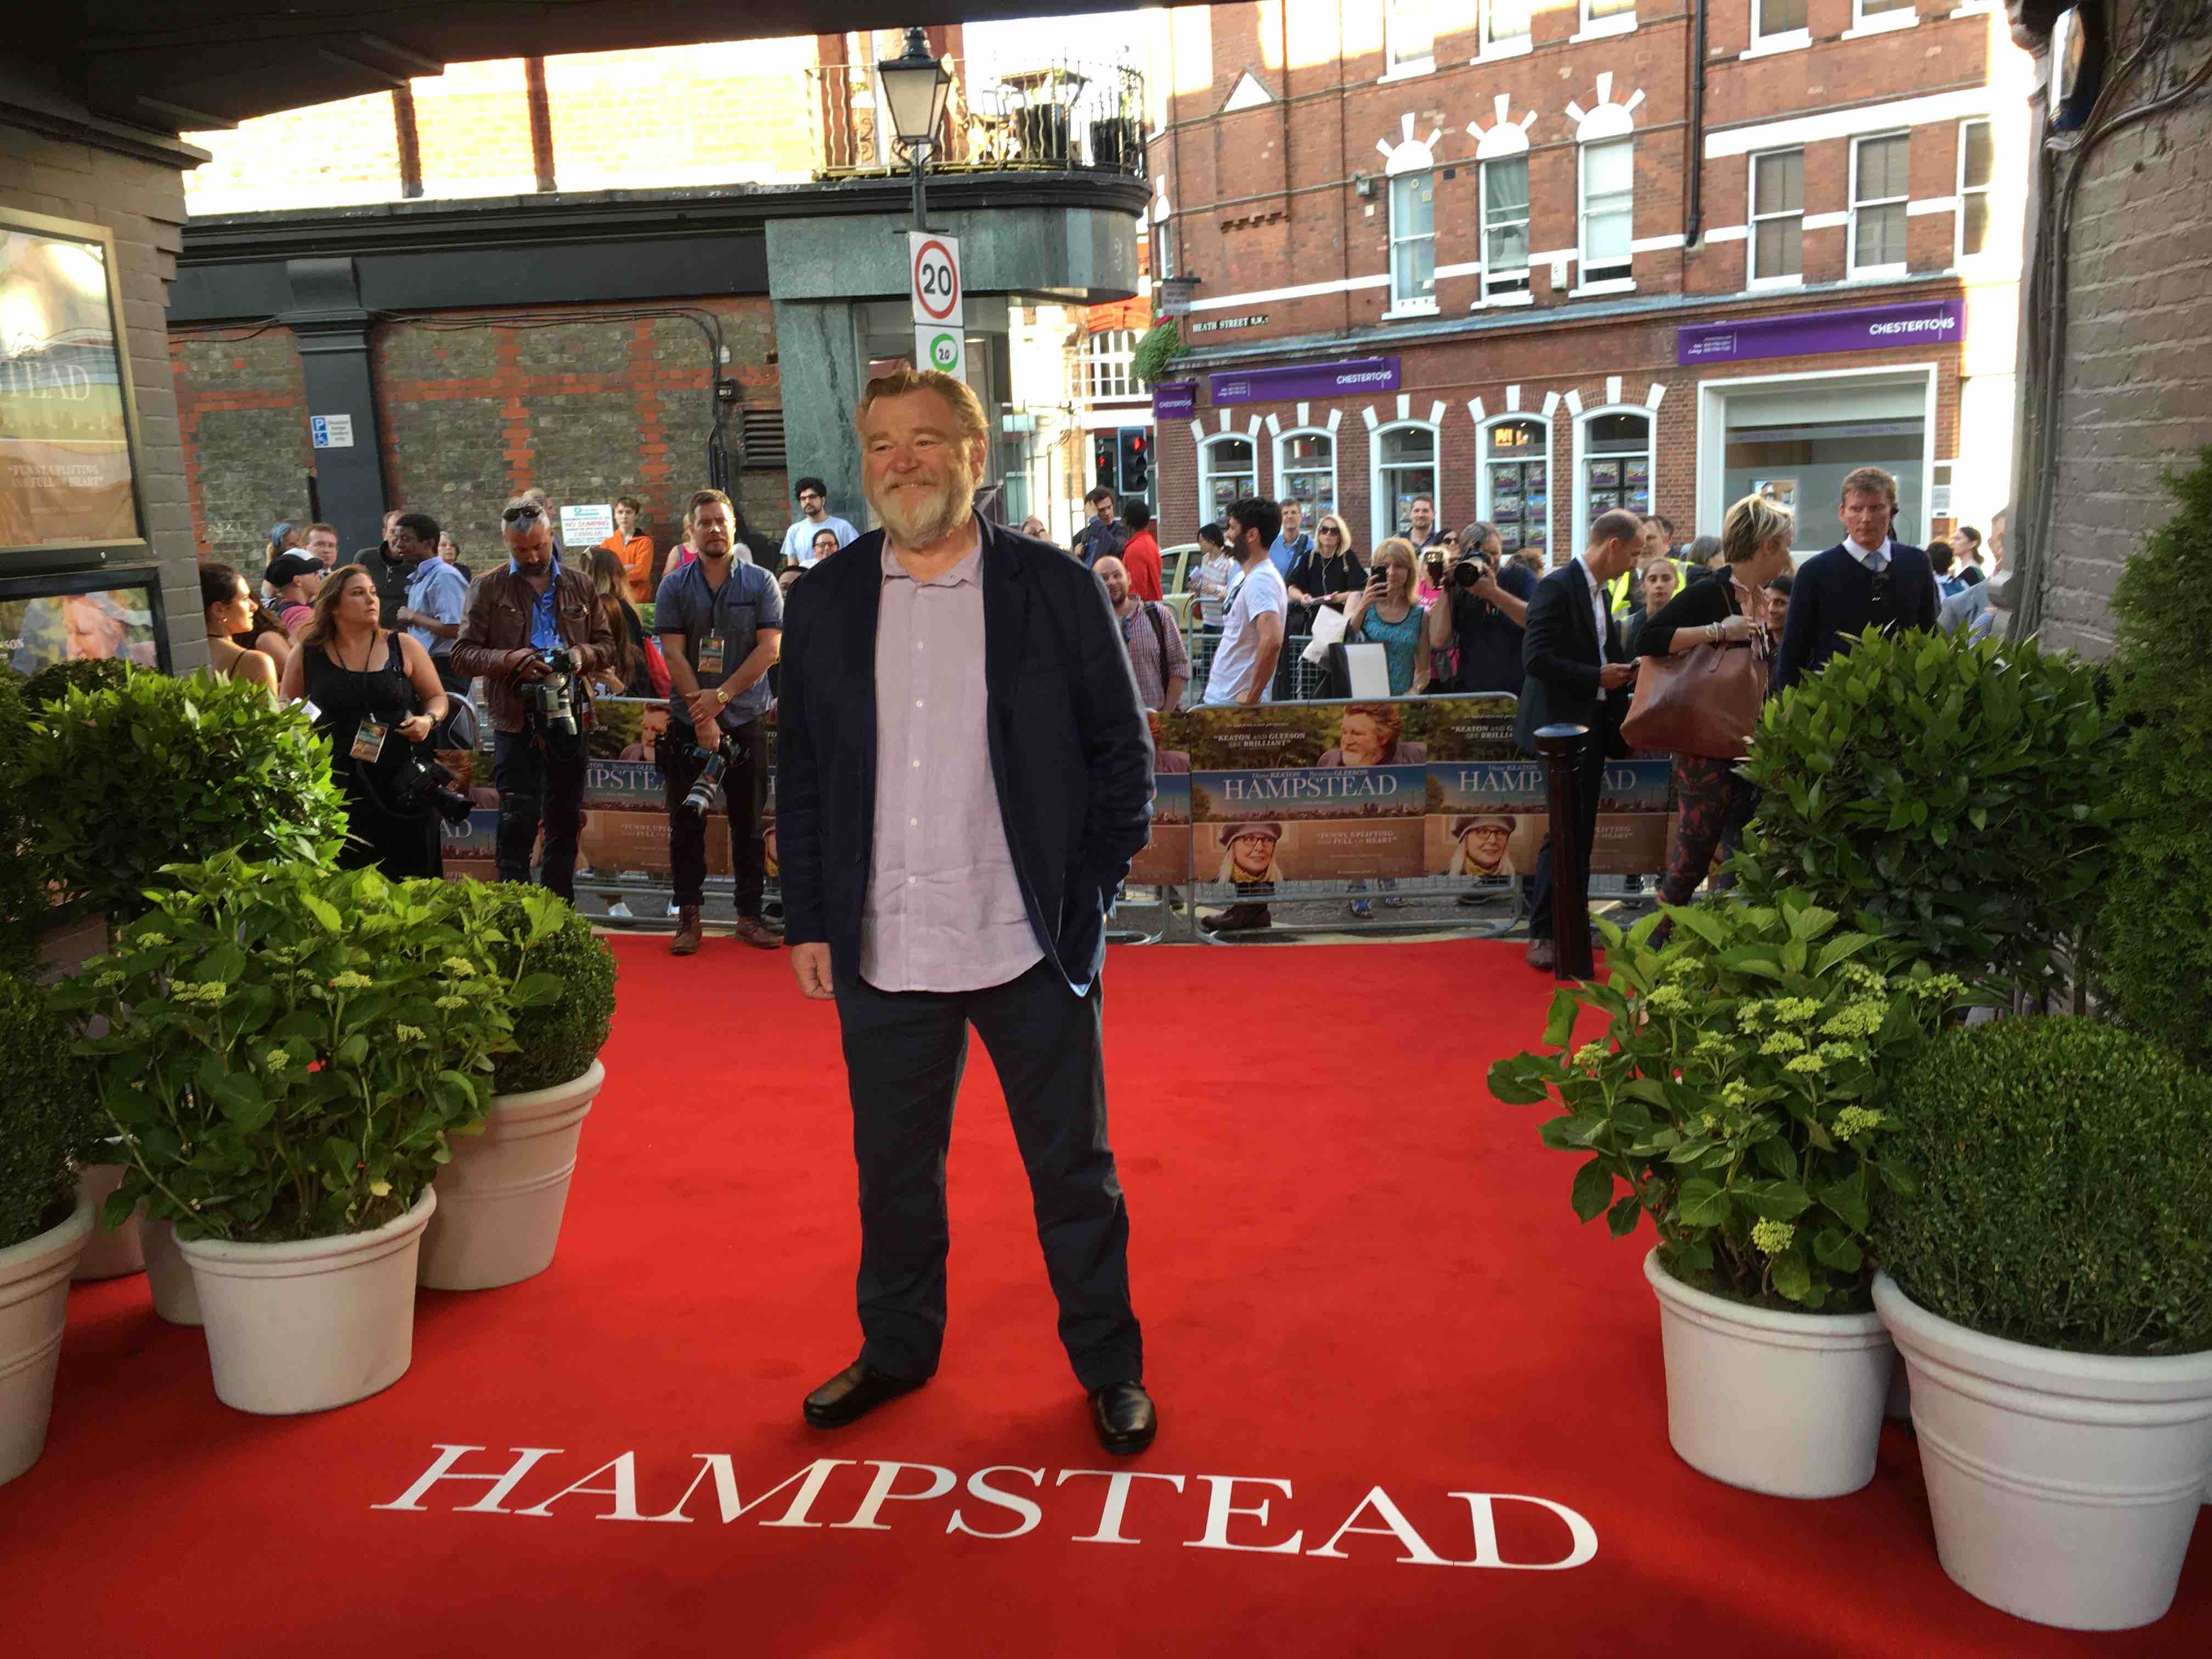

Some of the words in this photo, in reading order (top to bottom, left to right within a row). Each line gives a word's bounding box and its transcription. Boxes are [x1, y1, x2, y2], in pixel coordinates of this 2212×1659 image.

[922, 263, 951, 296] 20
[1193, 320, 1217, 333] HEATH
[1219, 317, 1249, 330] STREET
[1869, 317, 1955, 335] CHESTERTONS
[939, 348, 950, 360] 20
[1336, 370, 1392, 385] CHESTERTONS
[1223, 774, 1398, 800] HAMPSTEAD
[371, 1444, 1598, 1570] HAMPSTEAD
